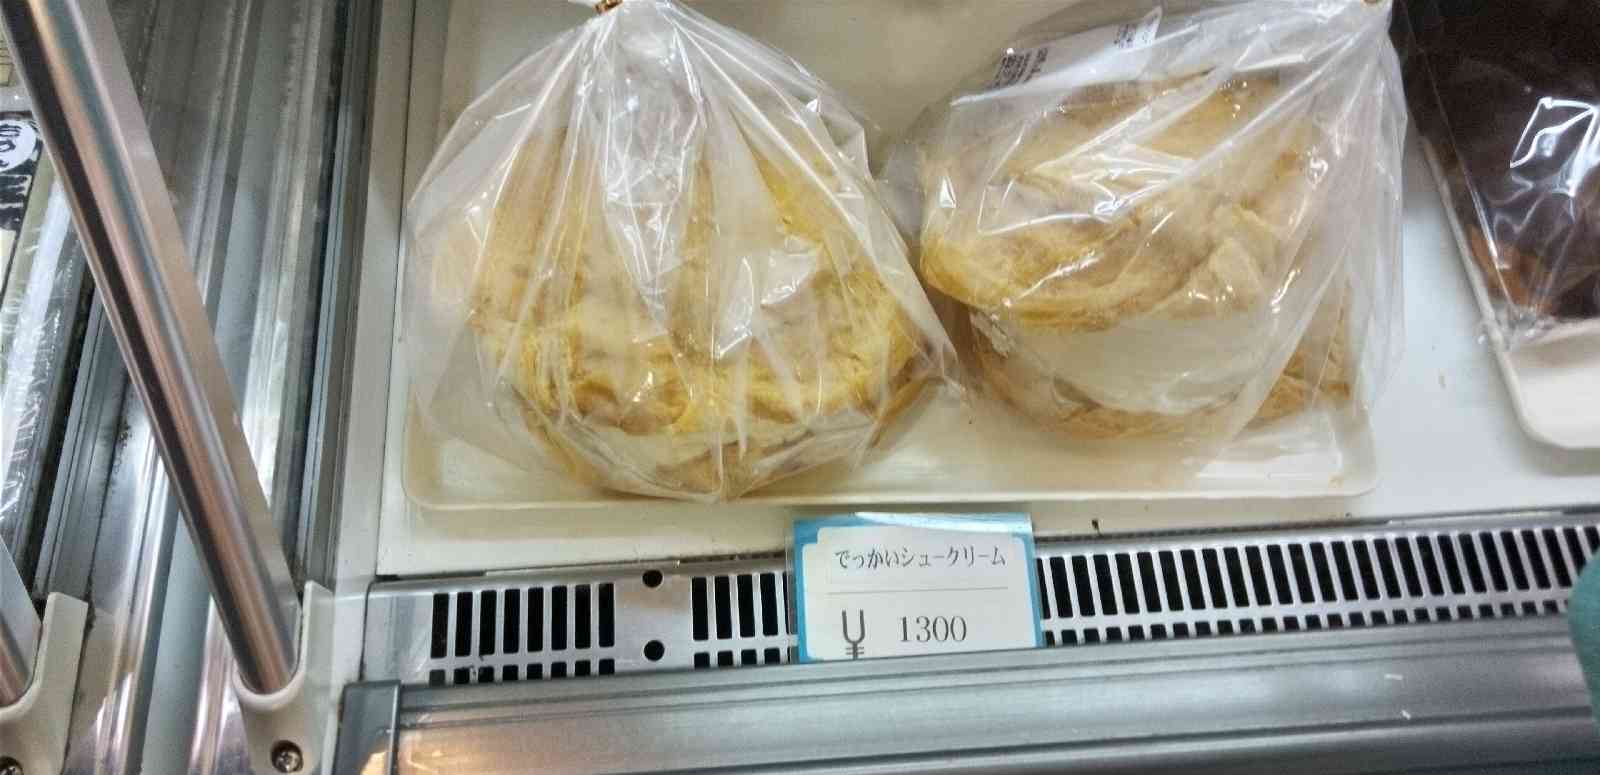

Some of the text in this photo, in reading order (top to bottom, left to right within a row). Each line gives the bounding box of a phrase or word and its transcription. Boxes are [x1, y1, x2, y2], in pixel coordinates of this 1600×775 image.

[834, 546, 1006, 569] でっかいシュークリーム
[900, 615, 967, 643] 1300
